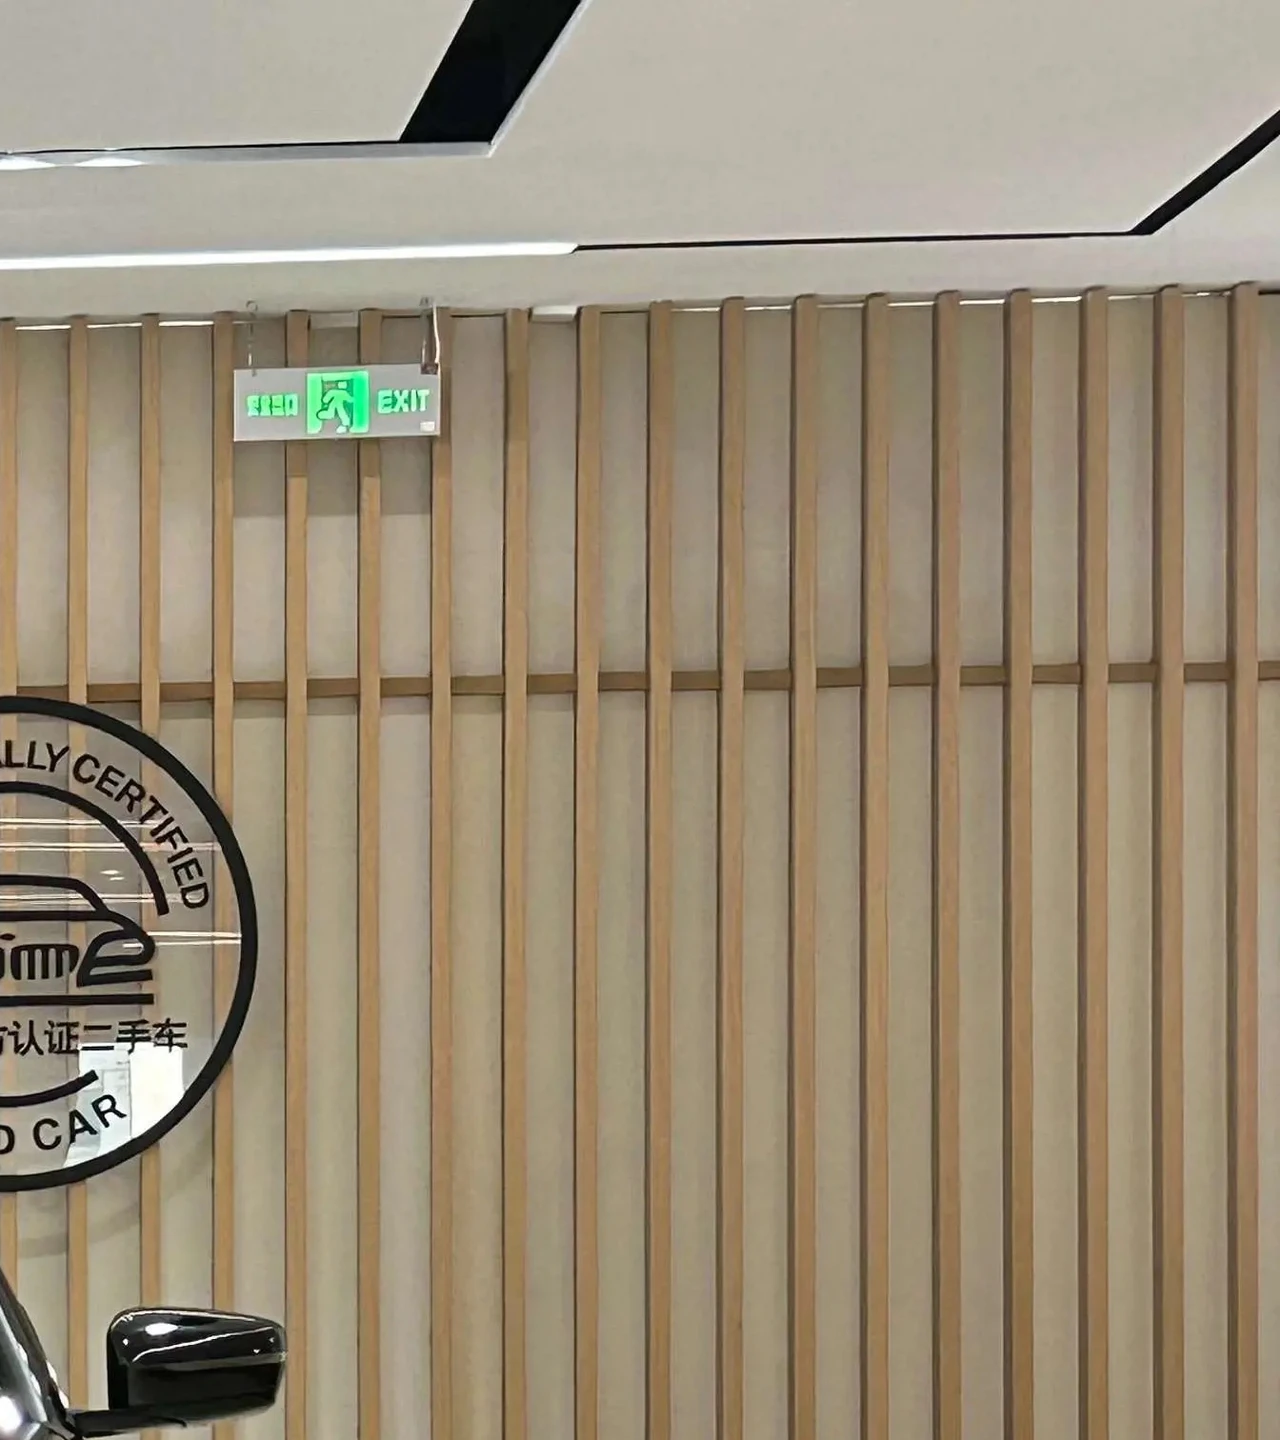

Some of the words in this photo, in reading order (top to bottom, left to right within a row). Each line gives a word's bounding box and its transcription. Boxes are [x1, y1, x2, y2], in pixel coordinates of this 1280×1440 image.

[377, 389, 430, 414] EXIT
[72, 752, 209, 910] CERTIFIED
[32, 1093, 128, 1151] CAR
